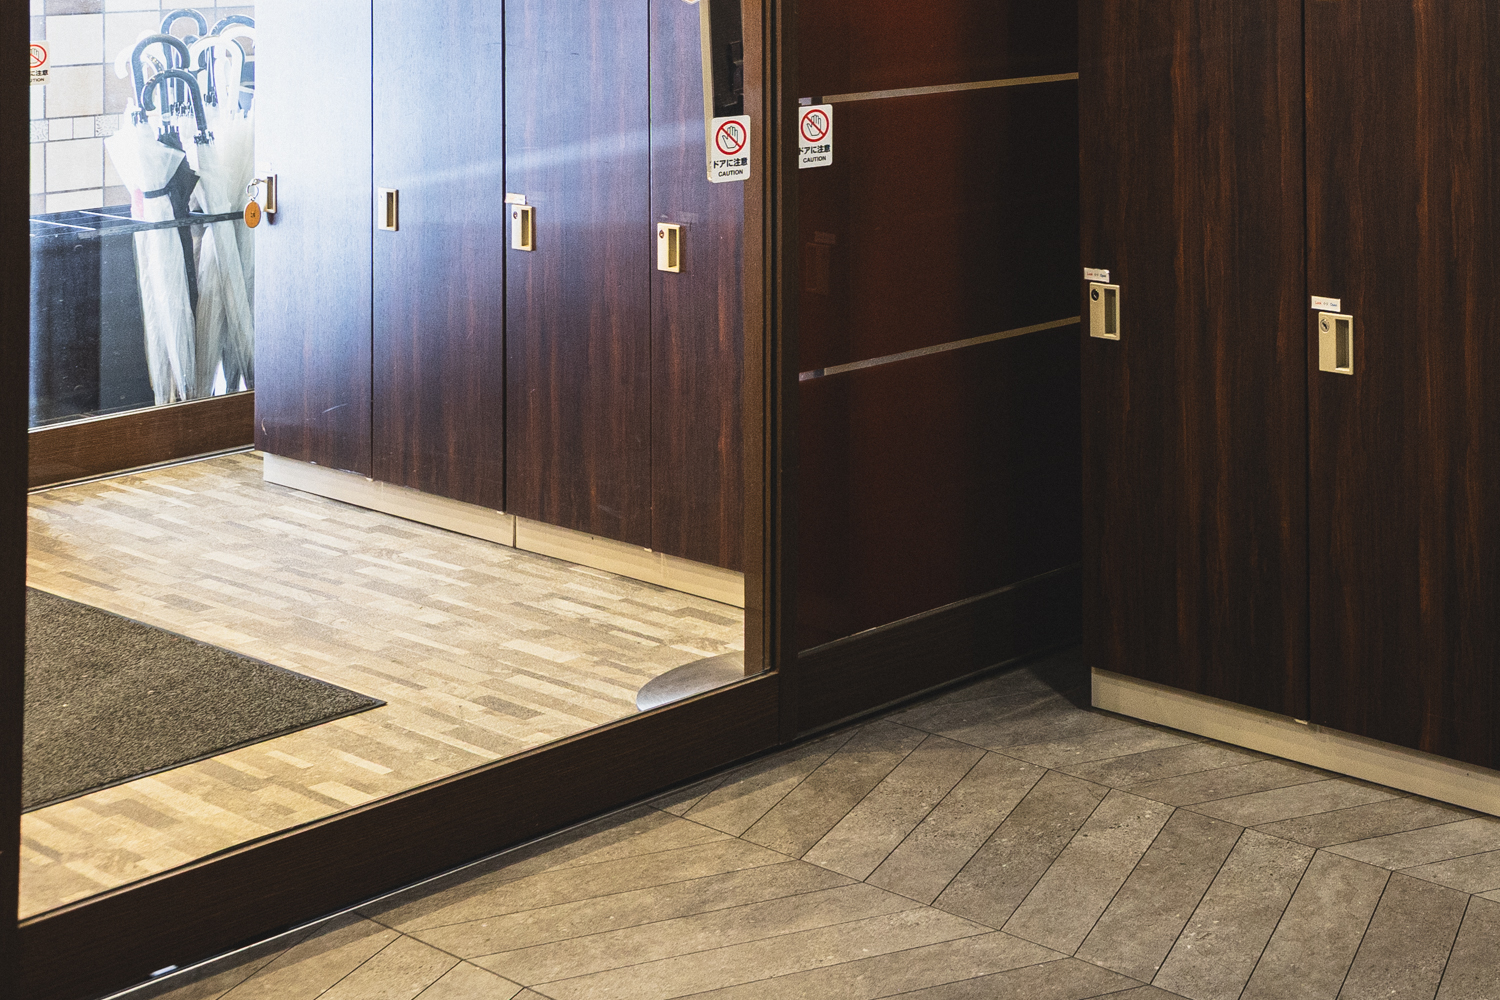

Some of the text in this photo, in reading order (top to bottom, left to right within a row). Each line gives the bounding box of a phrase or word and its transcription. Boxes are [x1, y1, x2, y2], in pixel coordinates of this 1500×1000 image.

[799, 144, 830, 156] ドアに注意
[713, 157, 748, 169] ドアに注意
